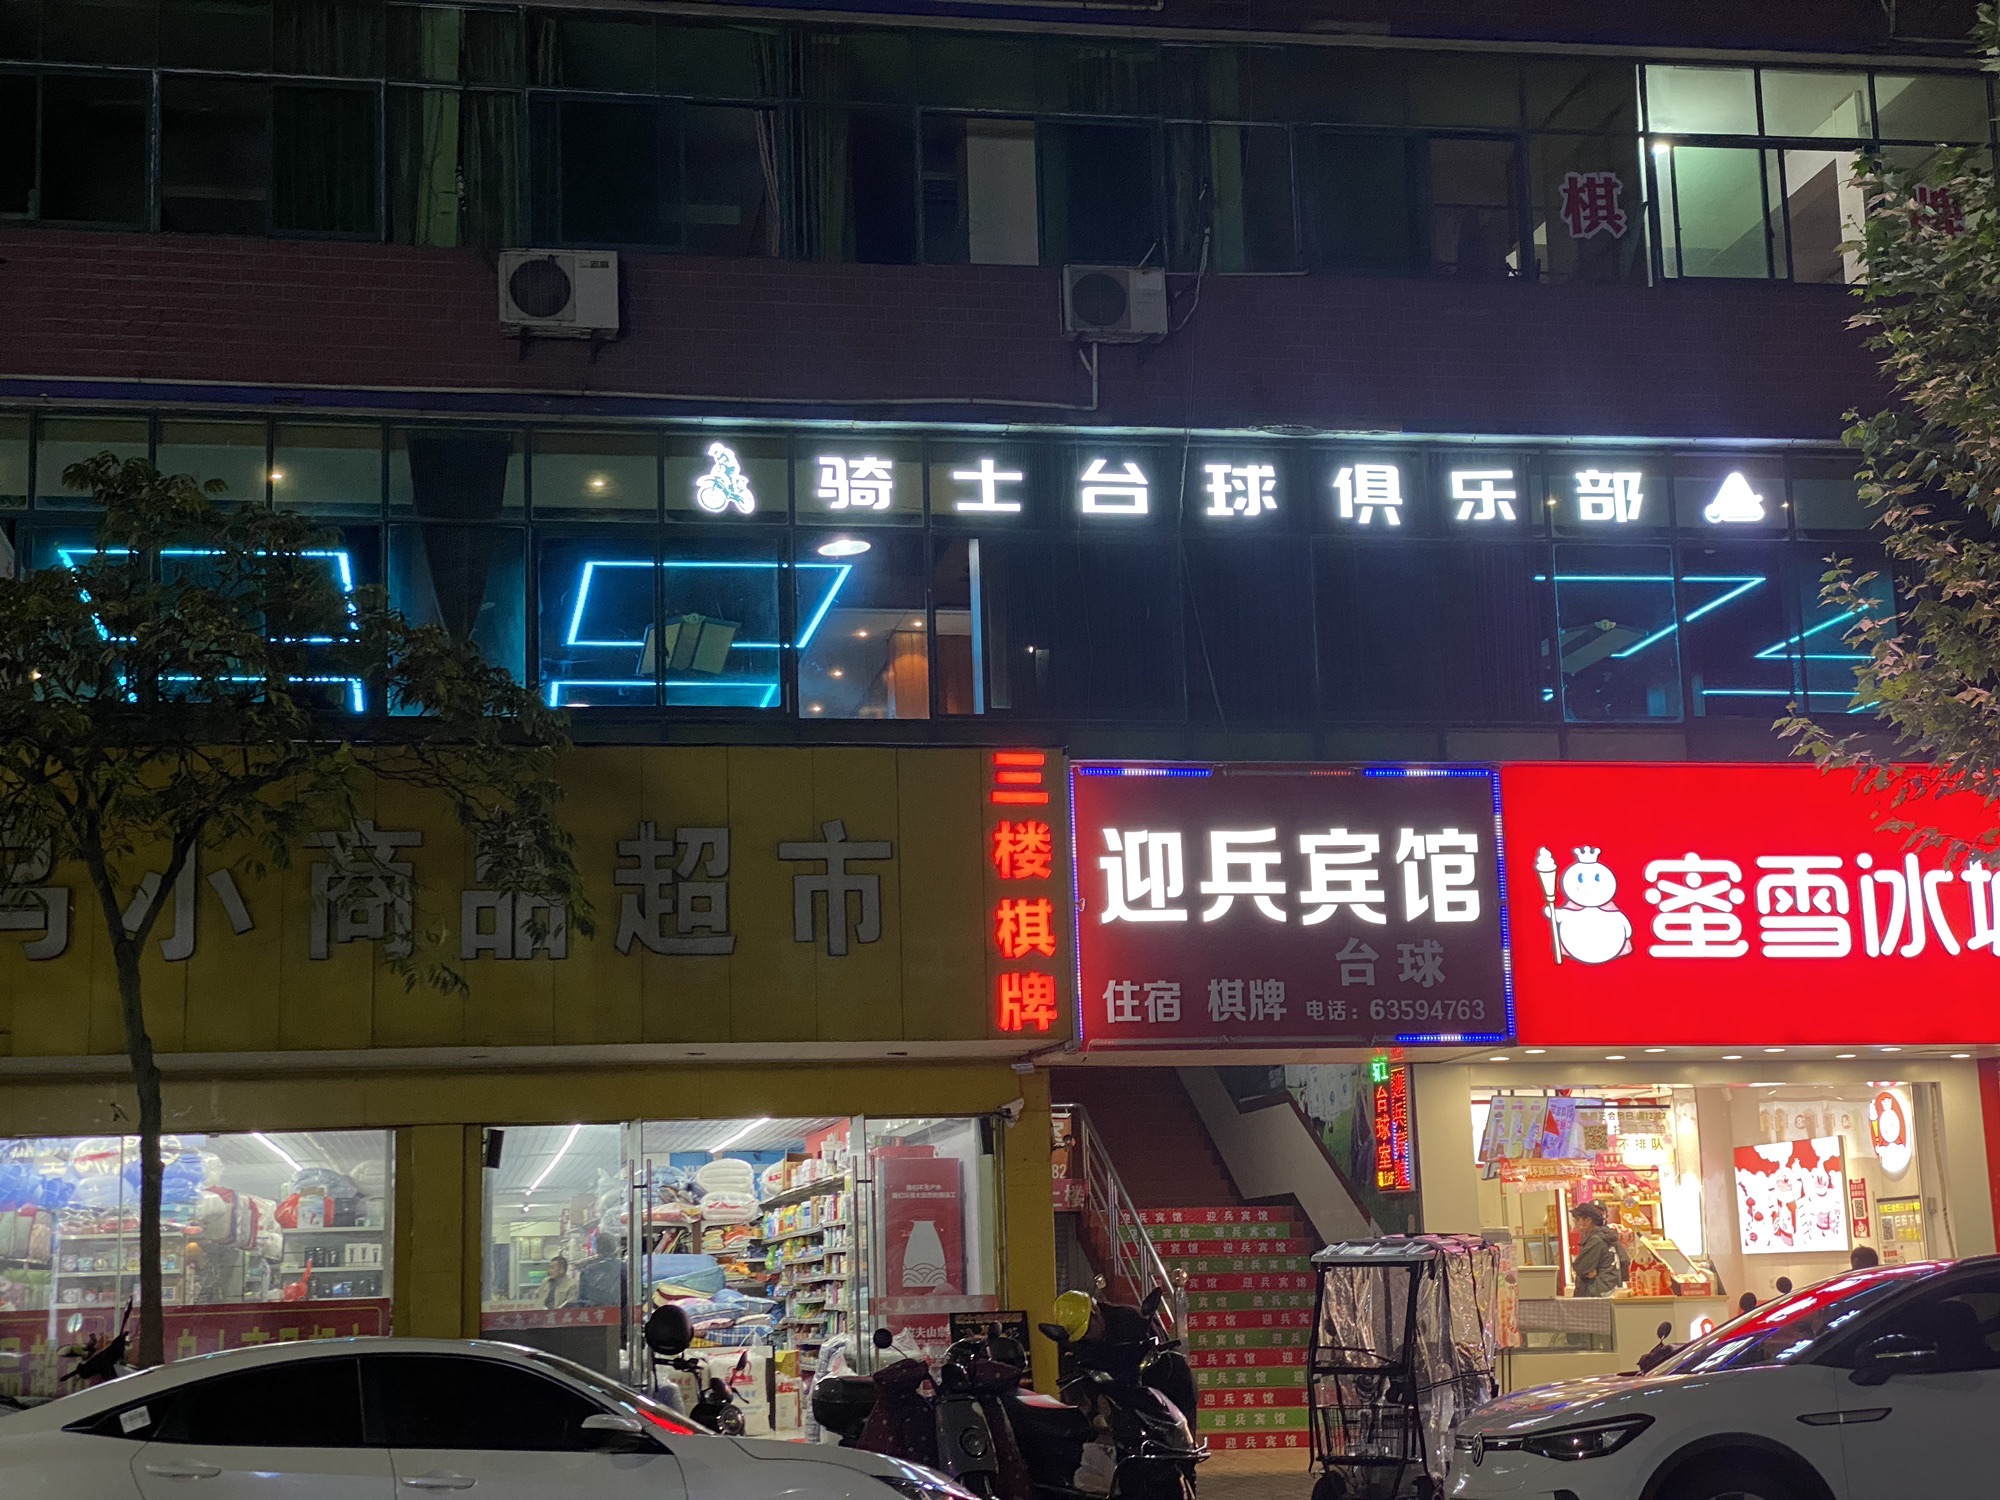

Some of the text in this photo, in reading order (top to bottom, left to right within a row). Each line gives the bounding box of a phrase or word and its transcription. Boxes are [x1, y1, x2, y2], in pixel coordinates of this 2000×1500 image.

[1560, 172, 1627, 239] 棋
[816, 455, 1644, 525] 骑士台球俱乐部
[1099, 827, 1481, 926] 迎兵宾馆
[990, 752, 1059, 1032] 三楼棋牌
[1335, 937, 1447, 989] 台球
[1102, 980, 1181, 1024] 住宿
[1207, 978, 1288, 1022] 棋牌
[1206, 1210, 1269, 1222] 迎兵宾馆
[1213, 1226, 1277, 1238] 迎兵宾馆
[1223, 1241, 1287, 1253] 迎兵宾馆
[1232, 1259, 1297, 1271] 迎兵宾馆
[1242, 1276, 1308, 1289] 迎兵宾馆
[1188, 1352, 1256, 1366] 迎兵宾馆
[1198, 1371, 1267, 1385] 迎兵宾馆
[1203, 1392, 1275, 1406] 迎兵宾馆
[1214, 1412, 1286, 1427] 迎兵宾馆
[1225, 1434, 1298, 1449] 迎兵宾馆
